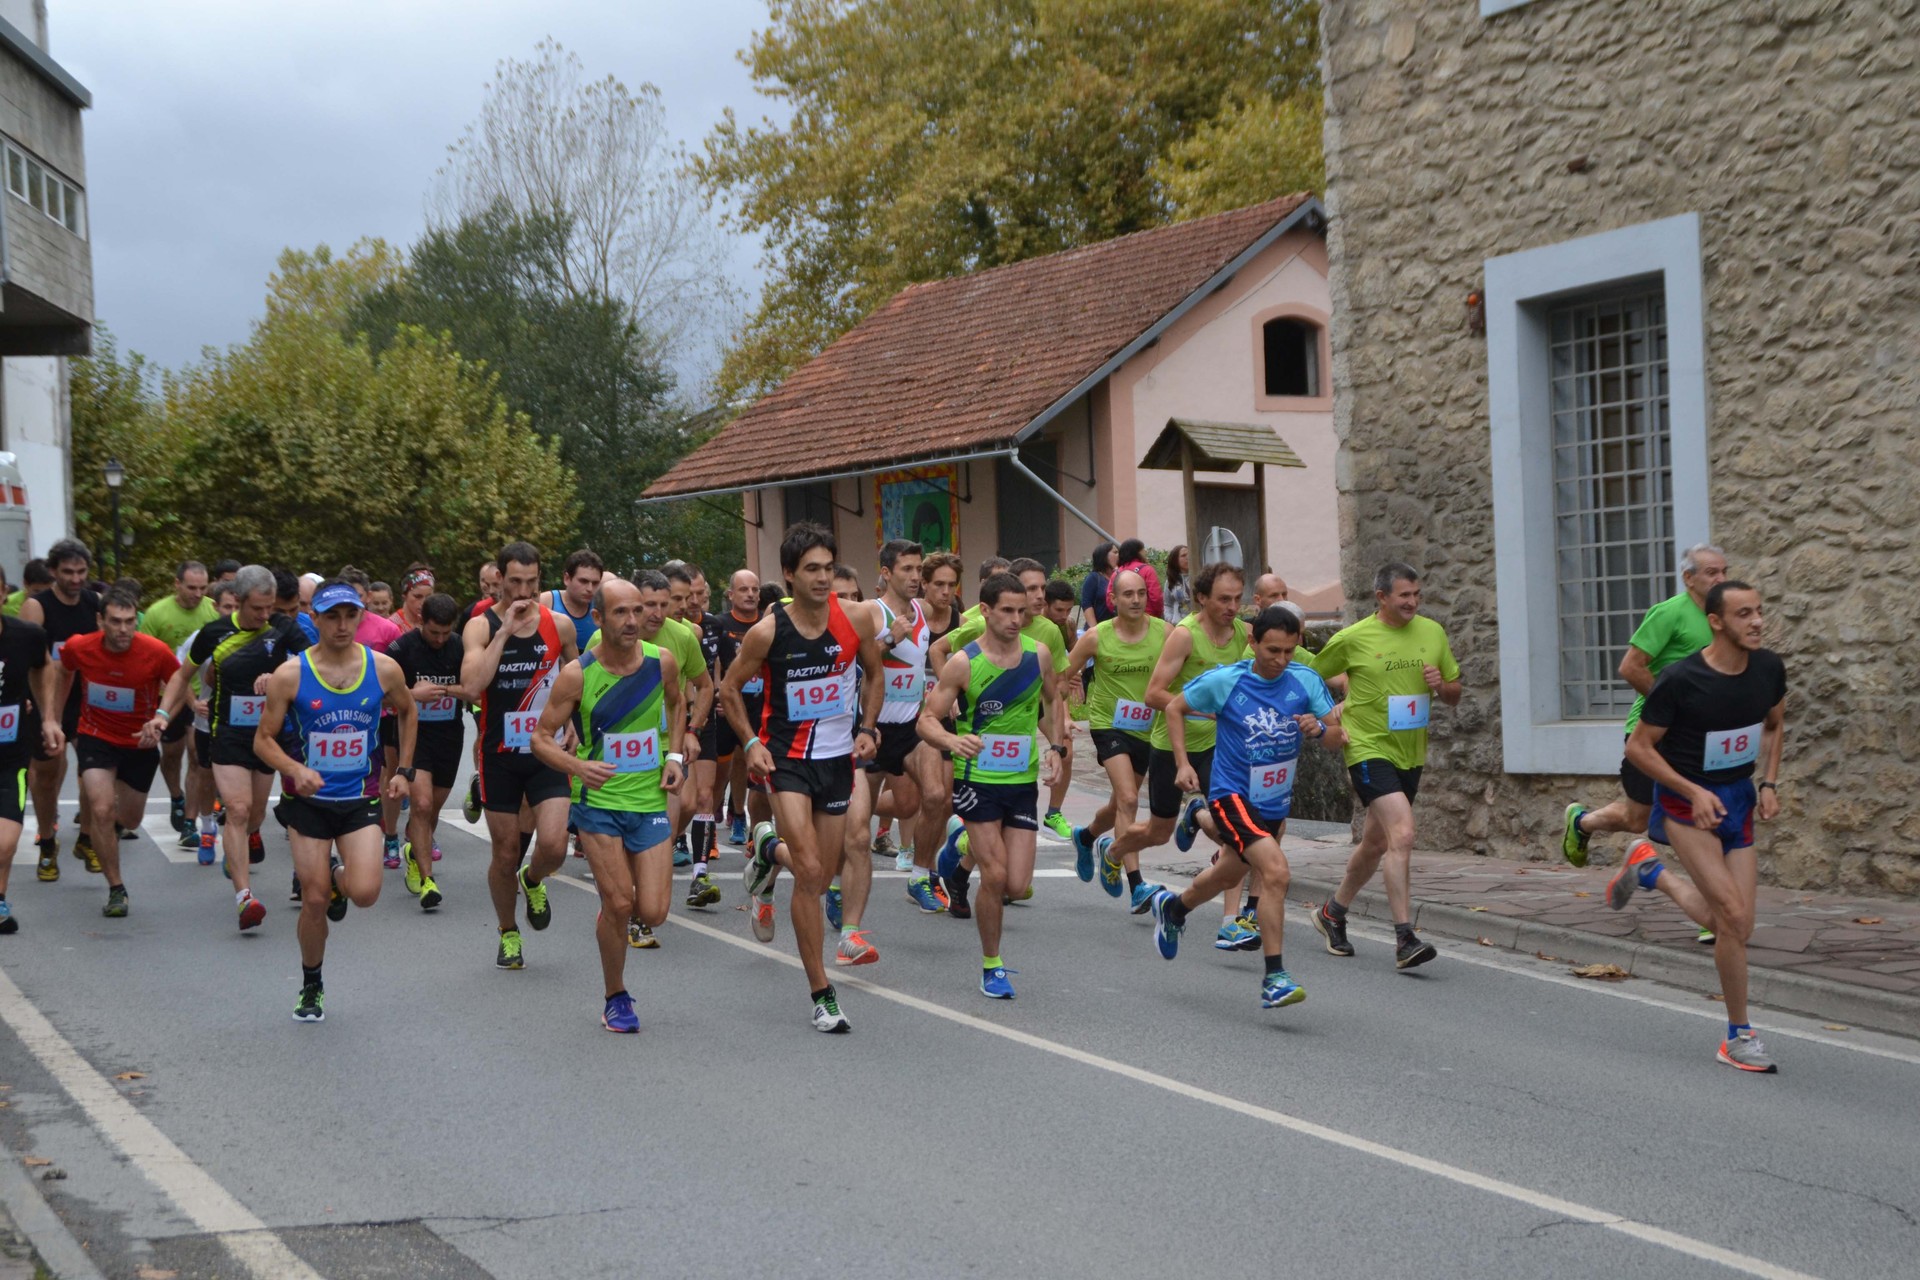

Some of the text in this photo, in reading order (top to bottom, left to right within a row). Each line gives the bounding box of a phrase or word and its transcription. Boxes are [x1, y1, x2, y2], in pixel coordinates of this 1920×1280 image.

[499, 661, 537, 672] BAZTAN
[787, 665, 829, 678] BAZTAN
[1384, 658, 1424, 671] Zalain
[891, 674, 915, 689] 47
[105, 690, 118, 702] 8
[793, 683, 840, 706] 192
[1120, 705, 1153, 721] 188
[1407, 700, 1416, 716] 1
[314, 711, 338, 728] YEPA
[352, 710, 373, 725] SHOP
[511, 717, 538, 734] 18
[315, 738, 363, 757] 185
[610, 736, 653, 758] 191
[991, 741, 1020, 758] 55
[1721, 735, 1748, 755] 18
[1262, 768, 1288, 788] 58
